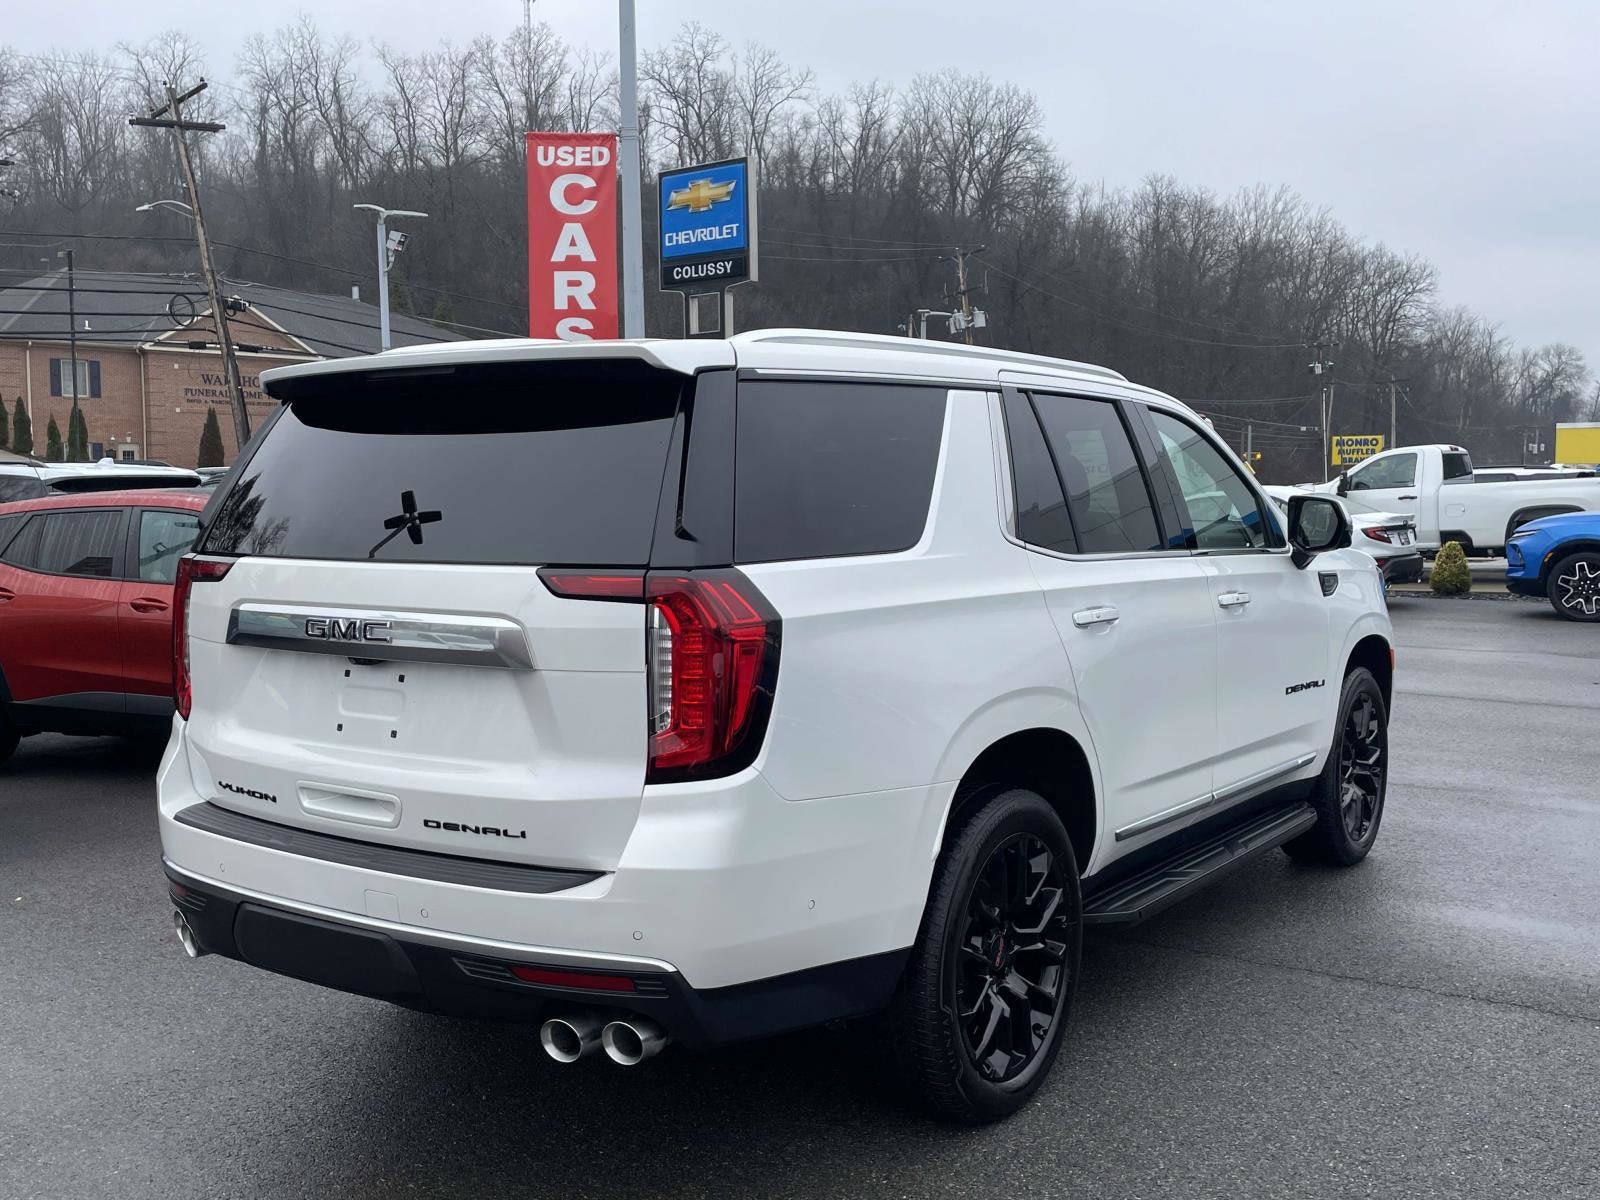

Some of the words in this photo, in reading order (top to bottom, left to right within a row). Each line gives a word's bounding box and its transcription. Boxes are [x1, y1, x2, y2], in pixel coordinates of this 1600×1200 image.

[537, 146, 610, 167] USED
[665, 223, 740, 247] CHEVROLET
[673, 261, 733, 280] COLUSSY
[1335, 438, 1379, 447] MONRO
[305, 617, 392, 643] GMC
[1285, 679, 1325, 695] DENALI
[218, 780, 277, 803] YUKON
[423, 818, 526, 839] DENALI
